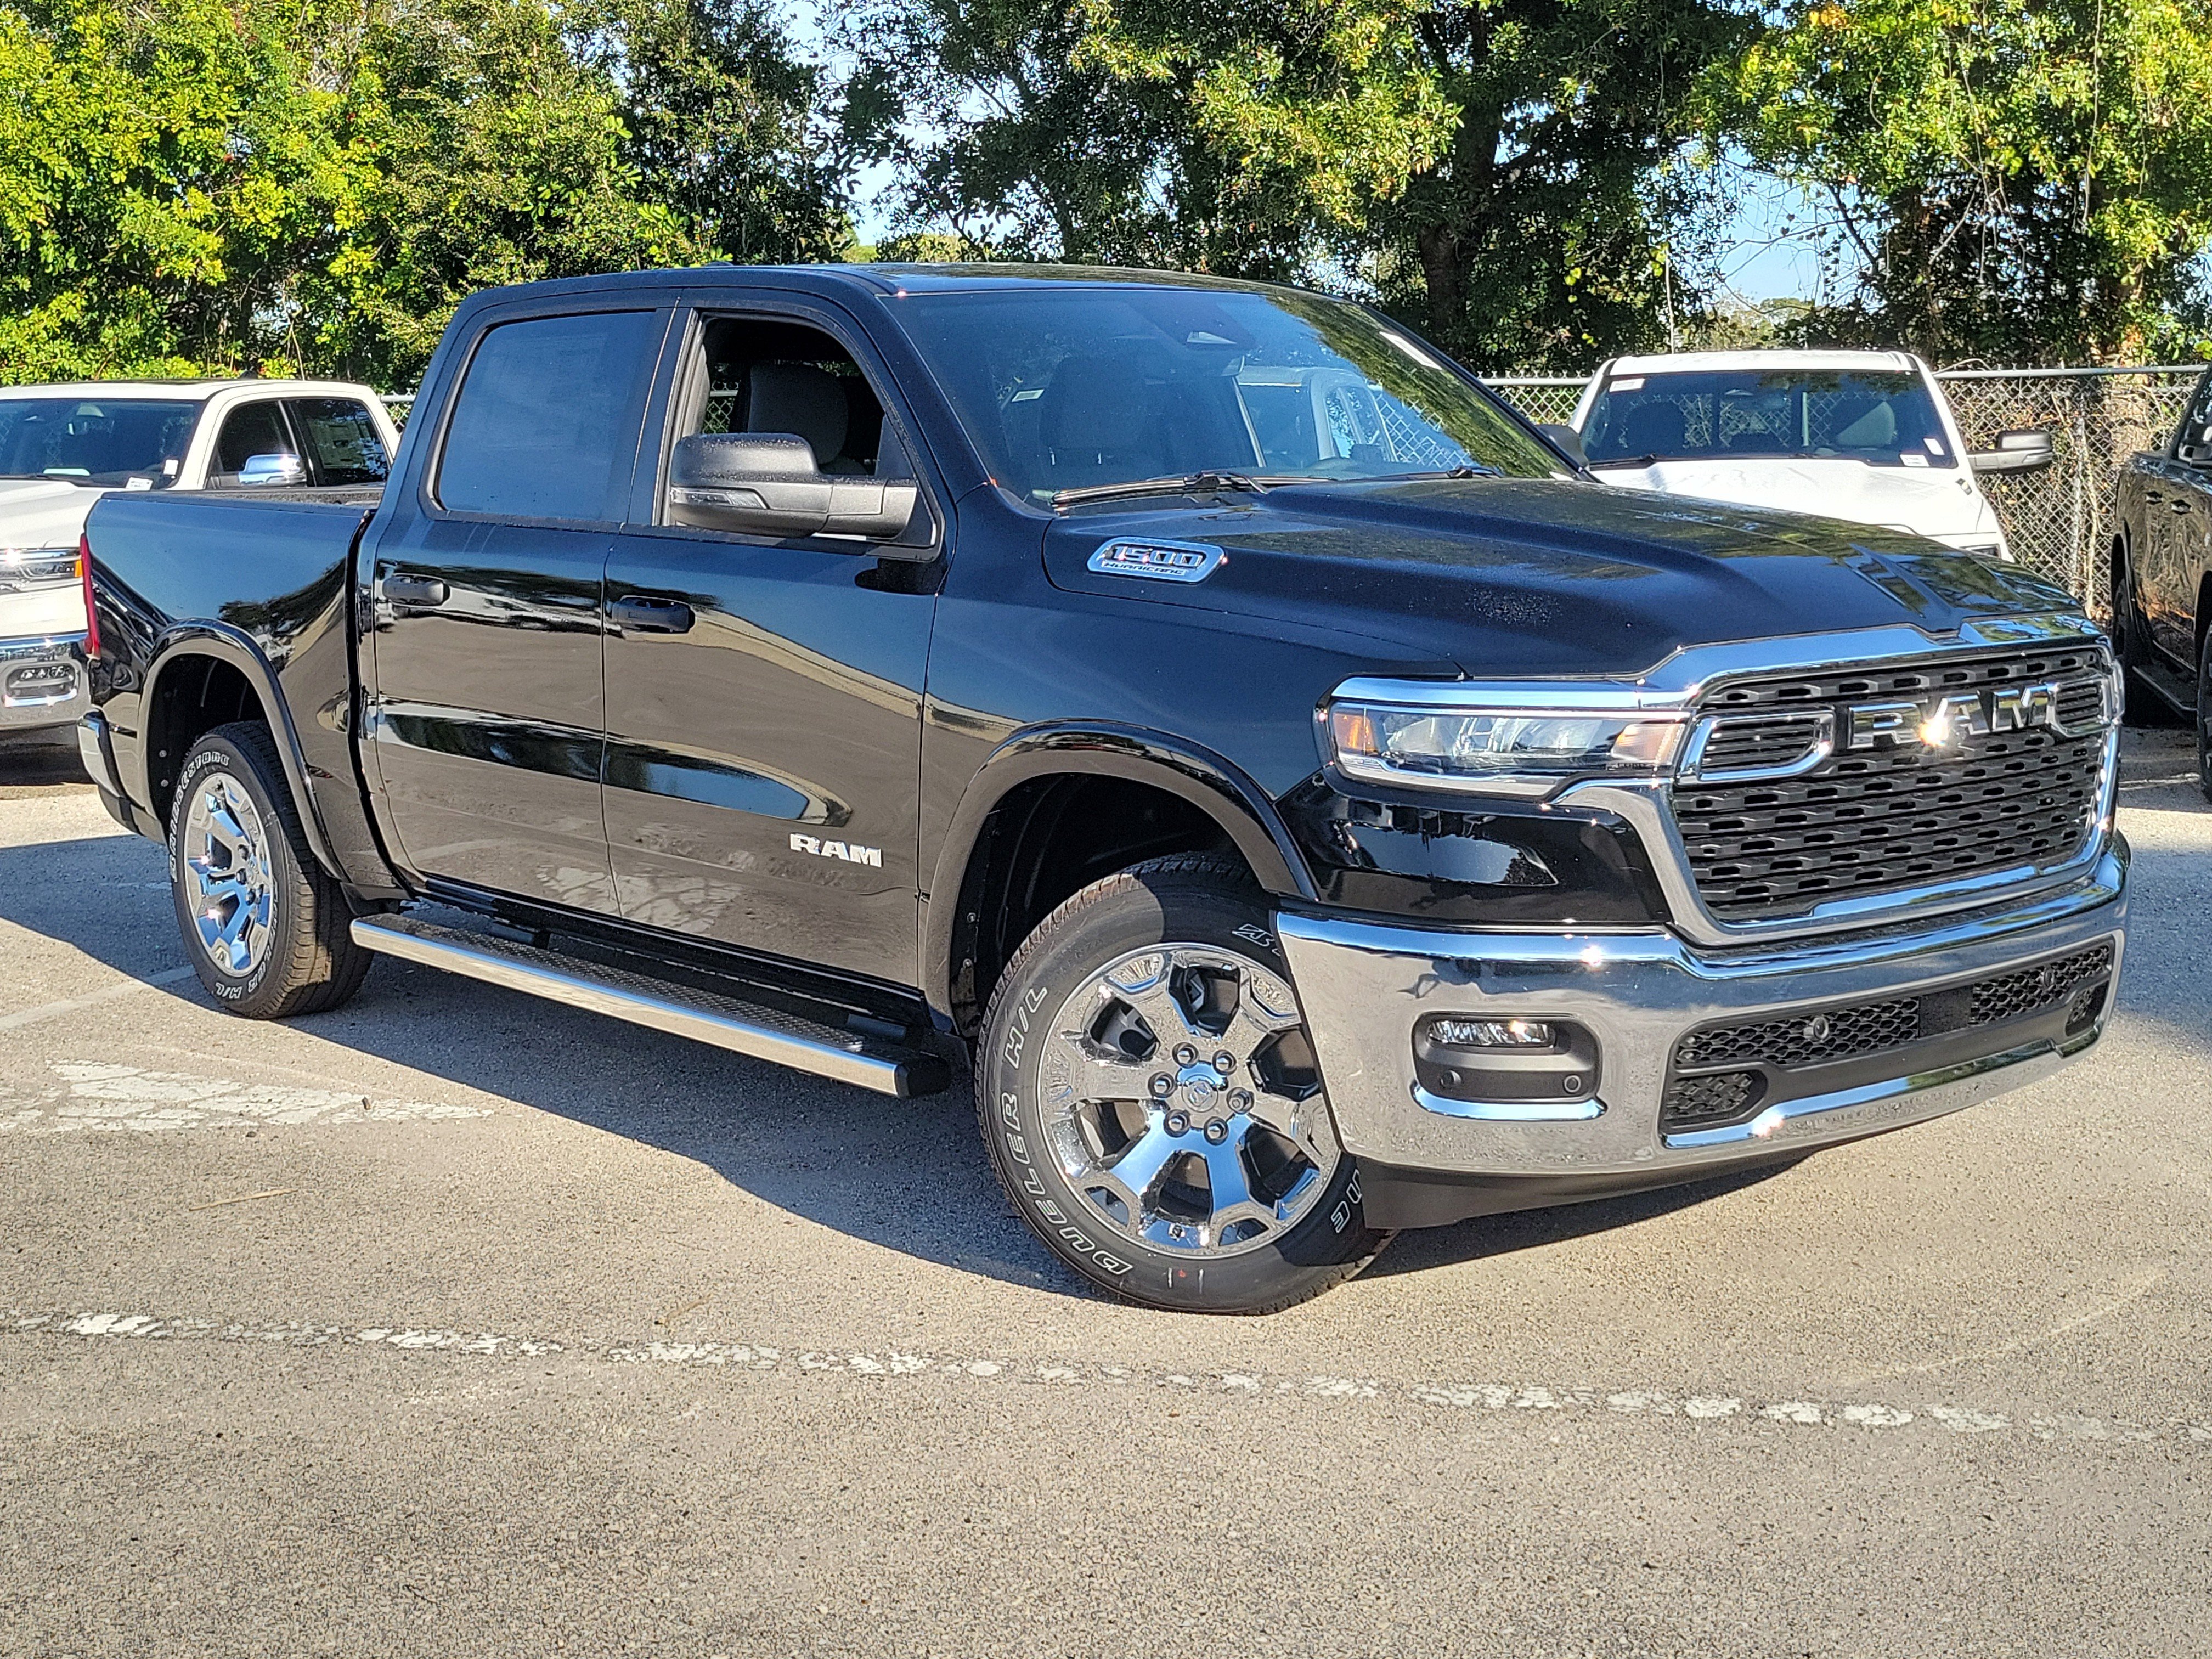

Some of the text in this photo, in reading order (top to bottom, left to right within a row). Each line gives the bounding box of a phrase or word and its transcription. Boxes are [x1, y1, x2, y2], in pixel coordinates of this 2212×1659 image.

[1109, 545, 1203, 569] 1500
[1847, 682, 2052, 749] RAM
[169, 751, 230, 883] BRIDGESTONE
[789, 832, 882, 868] RAM
[215, 982, 242, 999] H/L
[1001, 987, 1133, 1275] DUELER H/L
